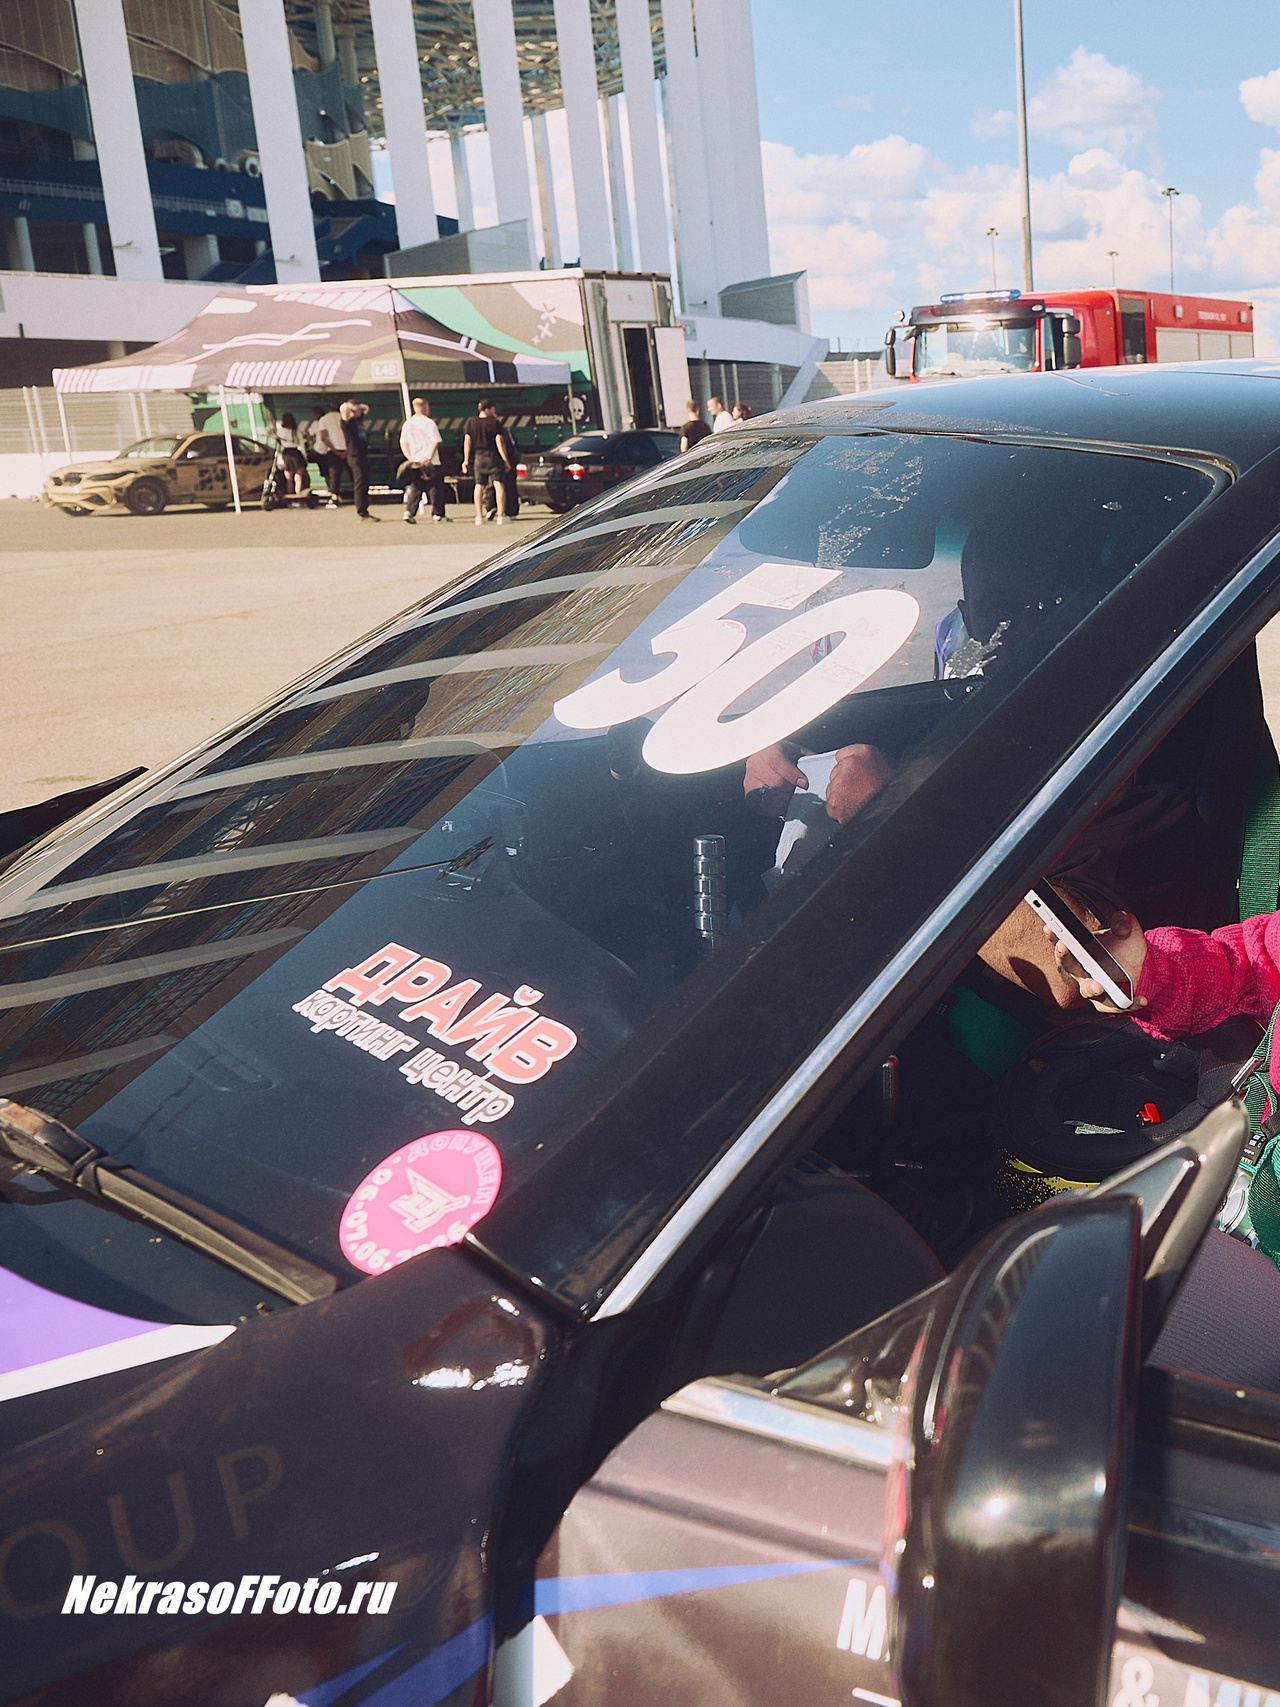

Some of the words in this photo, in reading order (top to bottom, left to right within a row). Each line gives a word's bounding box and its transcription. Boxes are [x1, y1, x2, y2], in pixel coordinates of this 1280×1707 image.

[553, 562, 921, 775] 50
[291, 989, 420, 1062] картинг
[398, 1047, 515, 1126] центр
[321, 942, 578, 1085] ДРАЙВ
